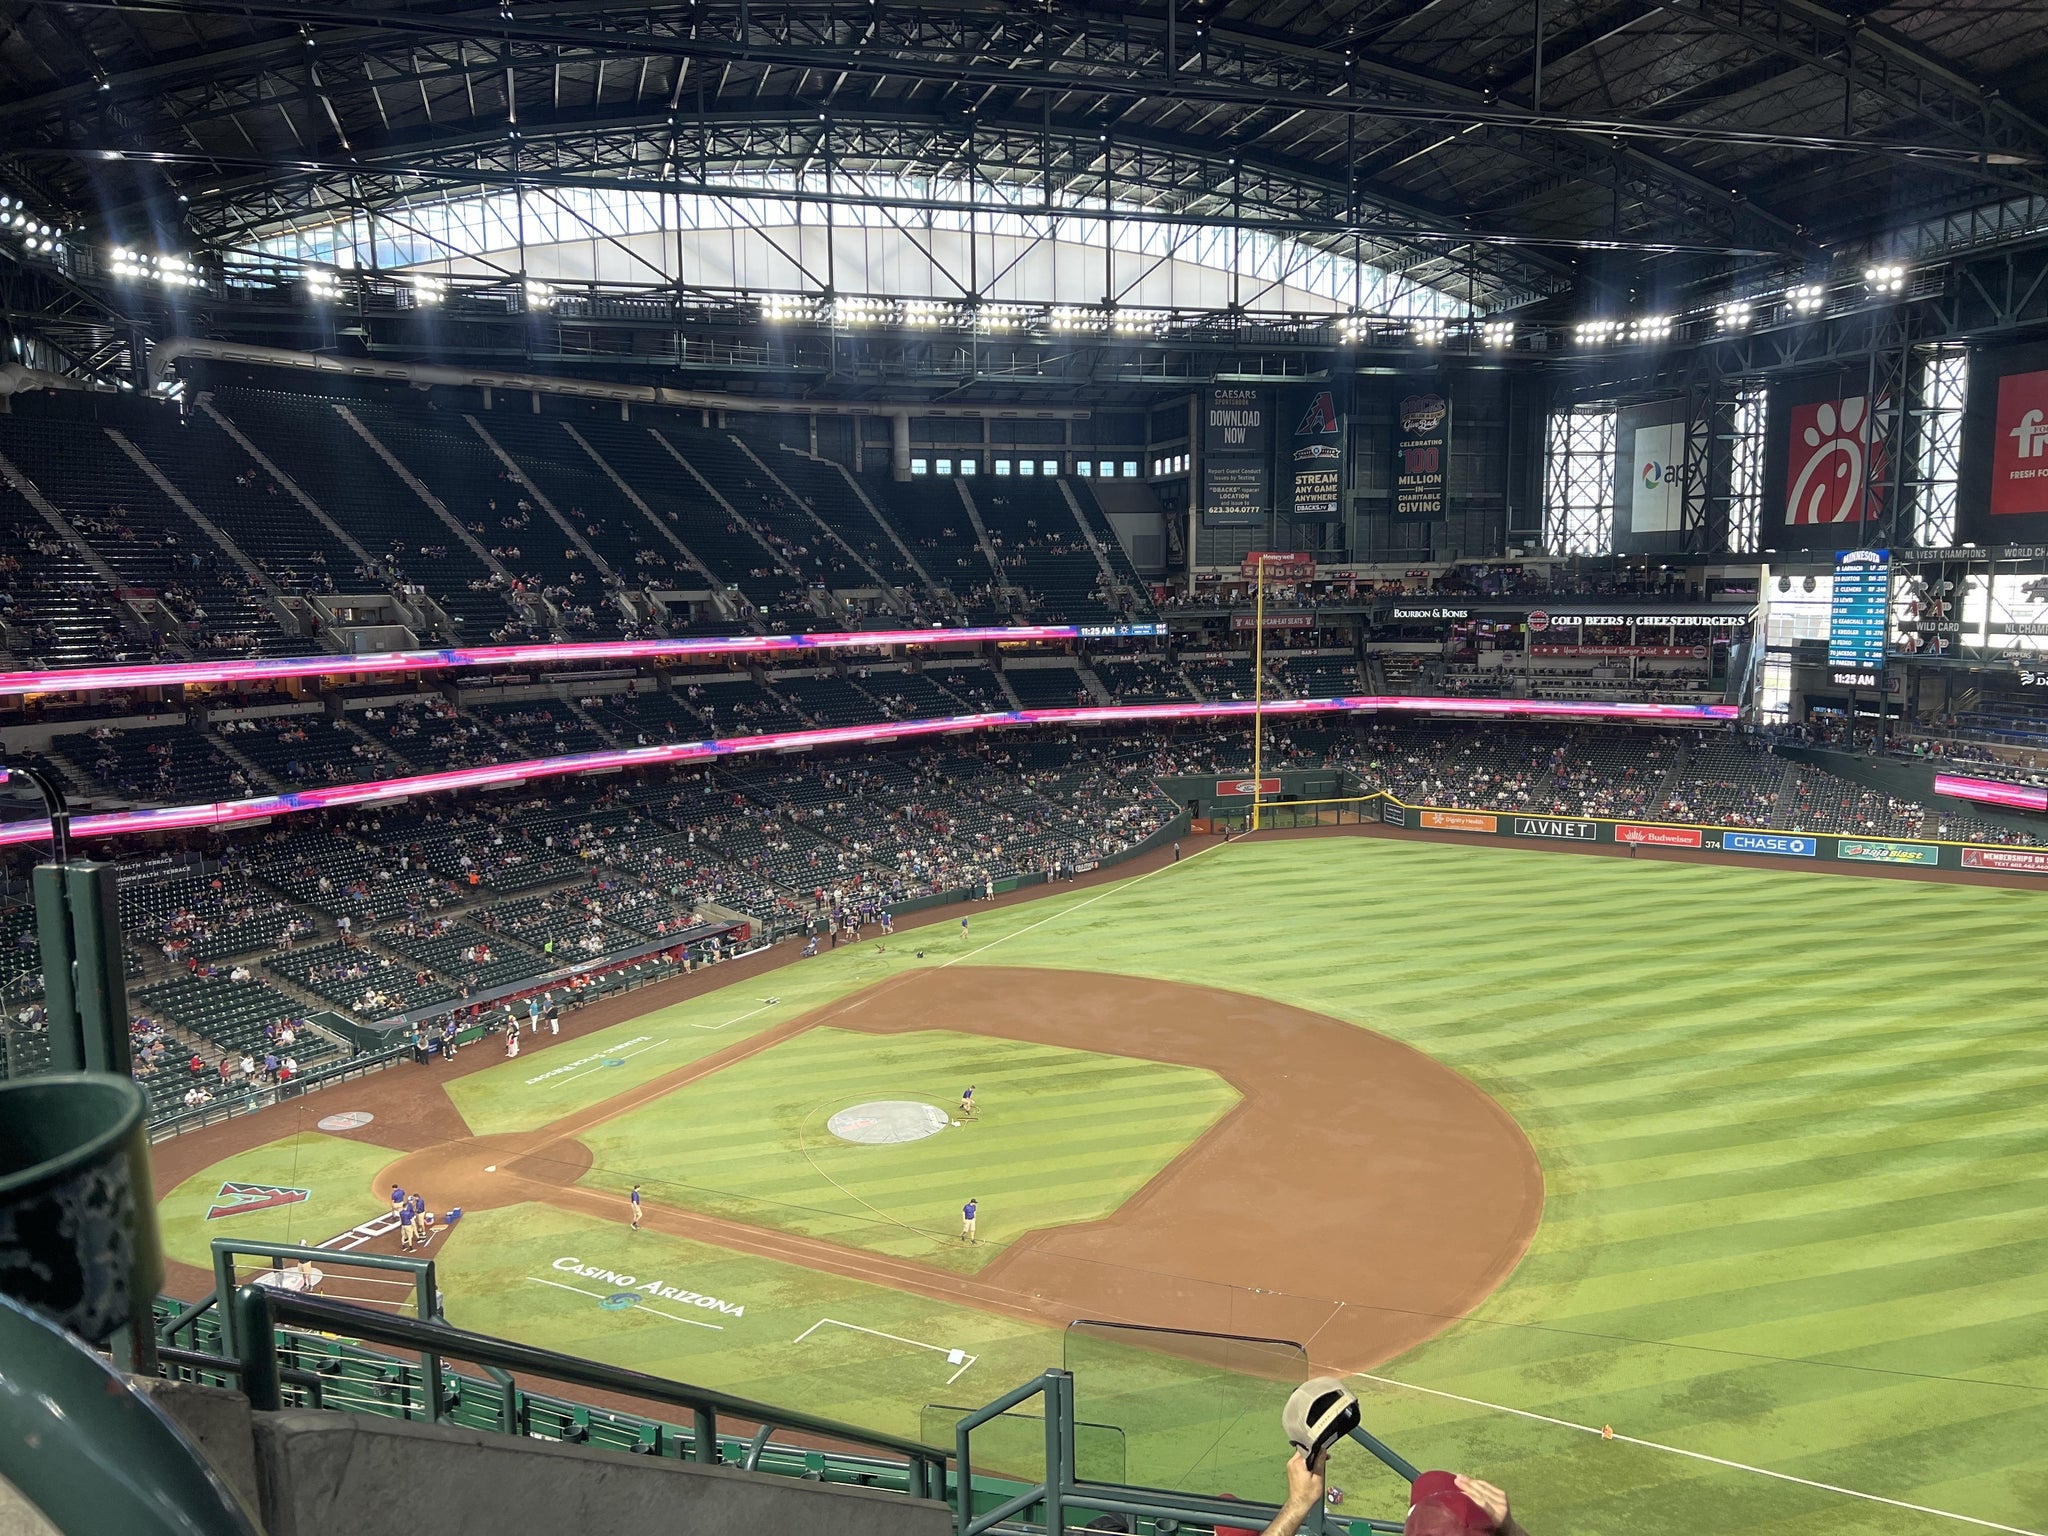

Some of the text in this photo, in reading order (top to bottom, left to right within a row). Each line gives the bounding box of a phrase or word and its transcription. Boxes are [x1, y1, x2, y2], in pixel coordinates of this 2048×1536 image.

[1214, 390, 1256, 399] CAESARS
[1210, 410, 1260, 426] DOWNLOAD
[1224, 427, 1246, 444] NOW
[1400, 439, 1443, 448] CELEBRATING
[1295, 474, 1338, 484] STREAM
[2010, 470, 2036, 479] FRESH
[1398, 474, 1442, 485] MILLION
[1295, 486, 1312, 494] ANY
[1295, 494, 1338, 502] ANYWHERE
[1398, 493, 1441, 501] CHARITABLE
[1398, 501, 1440, 513] GIVING
[1905, 551, 1914, 559] NL
[1940, 549, 1986, 558] CHAMPIONS
[2004, 548, 2032, 557] WORLD
[1843, 551, 1880, 564] MINNESOTA
[1432, 609, 1440, 618] &
[1551, 616, 1582, 625] COLD
[1584, 616, 1624, 625] BEERS
[1626, 616, 1634, 625] &
[1636, 616, 1746, 625] CHEESEBURGERS
[1081, 626, 1115, 635] 11:25 AM
[1916, 622, 1960, 632] WILD CARD
[2005, 624, 2016, 633] NL
[1564, 647, 1578, 655] Your
[1834, 673, 1874, 686] 11:25 AM
[1446, 816, 1464, 824] Dignity
[1523, 821, 1588, 837] AVNET
[1648, 833, 1693, 843] Budweiser
[1705, 841, 1720, 849] 374
[1734, 836, 1787, 850] CHASE
[1862, 848, 1924, 859] Baja Blast
[1984, 853, 2032, 863] MEMBERSHIPS
[144, 858, 173, 866] TERRACE
[162, 866, 191, 875] TERRACE
